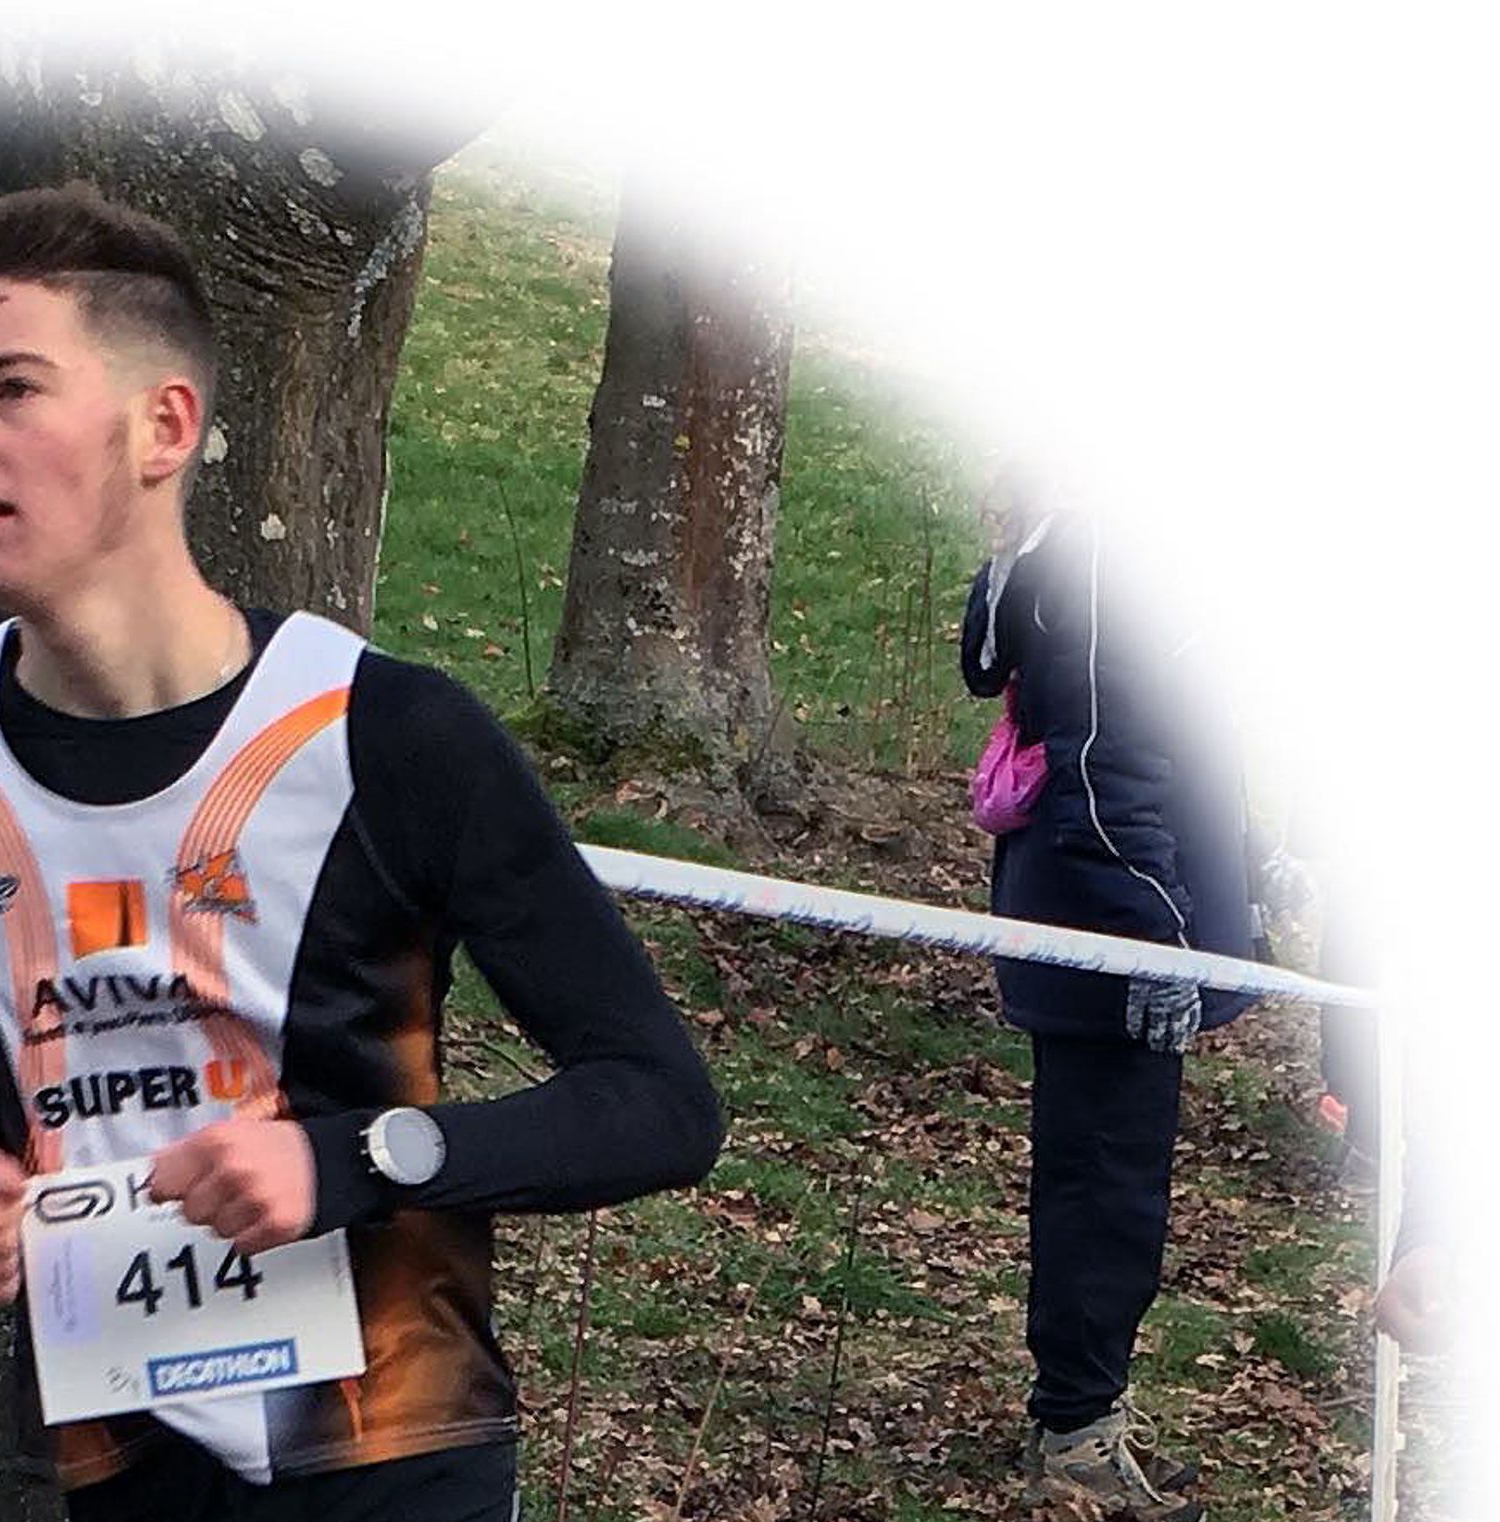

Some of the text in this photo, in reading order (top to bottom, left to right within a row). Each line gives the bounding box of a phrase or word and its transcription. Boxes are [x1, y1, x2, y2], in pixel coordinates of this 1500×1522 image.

[33, 974, 196, 1018] AVIVA
[36, 1061, 244, 1128] SUPER U
[116, 1243, 263, 1317] 414
